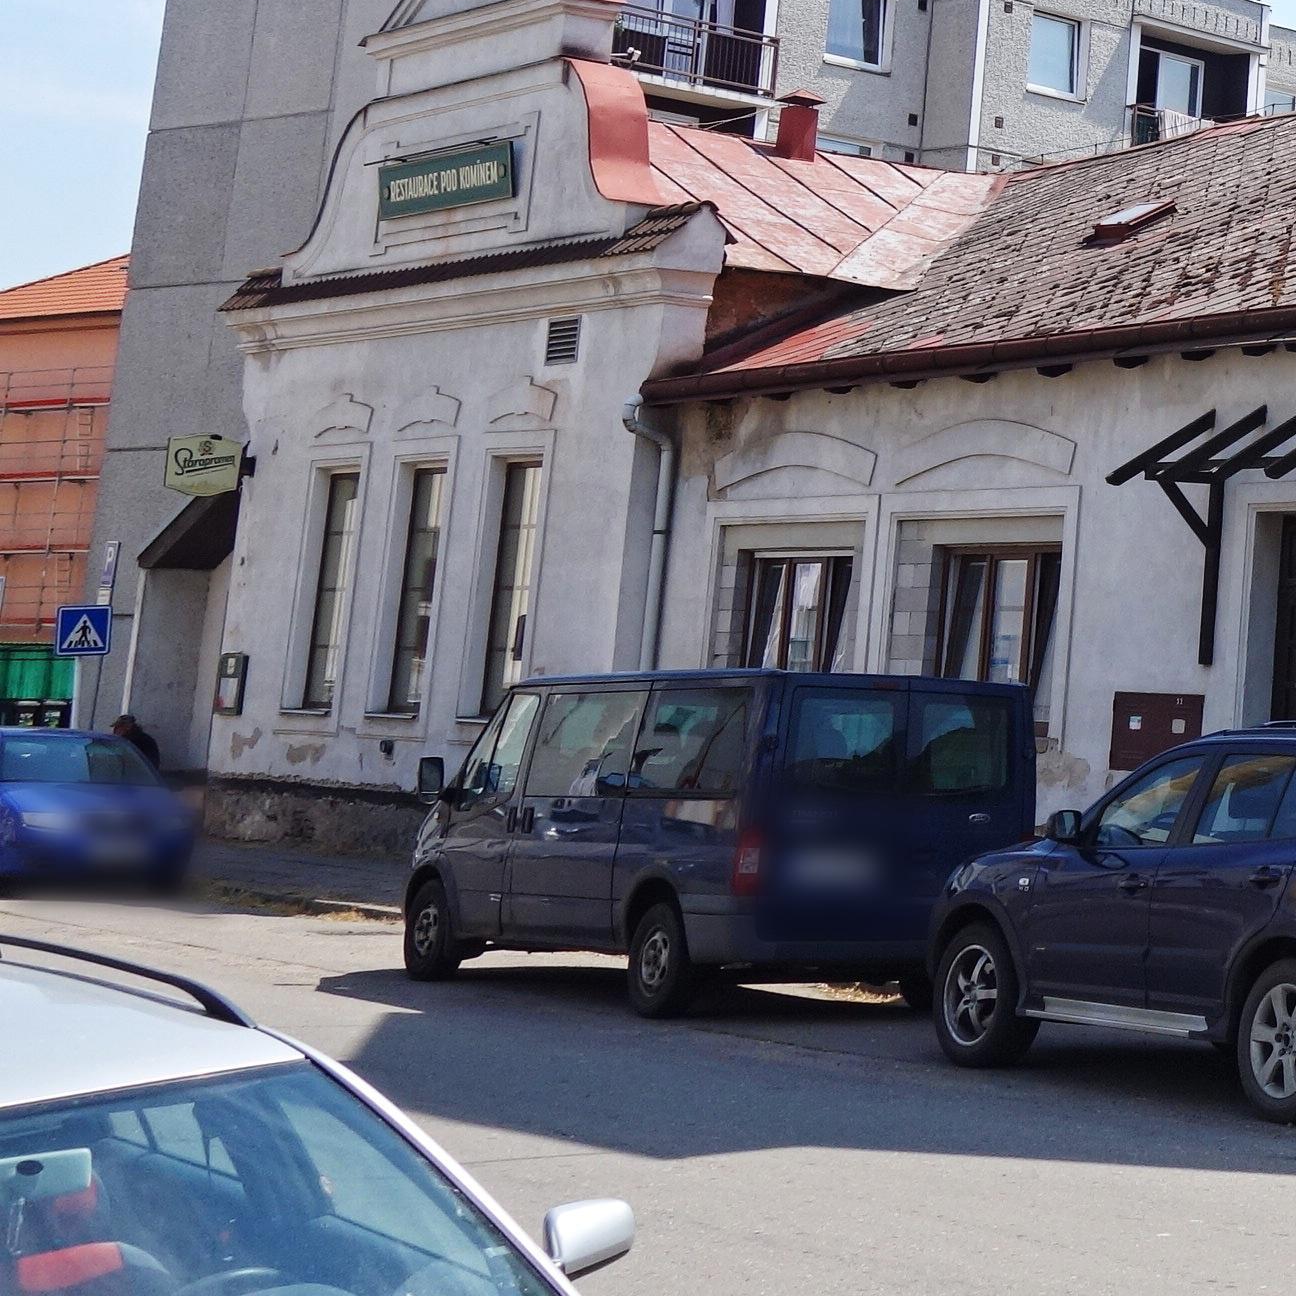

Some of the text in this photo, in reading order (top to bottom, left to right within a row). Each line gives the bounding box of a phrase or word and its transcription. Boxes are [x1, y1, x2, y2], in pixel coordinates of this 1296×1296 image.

[390, 160, 498, 202] RESTAURACE POD KOMÍNEM
[104, 546, 115, 572] P
